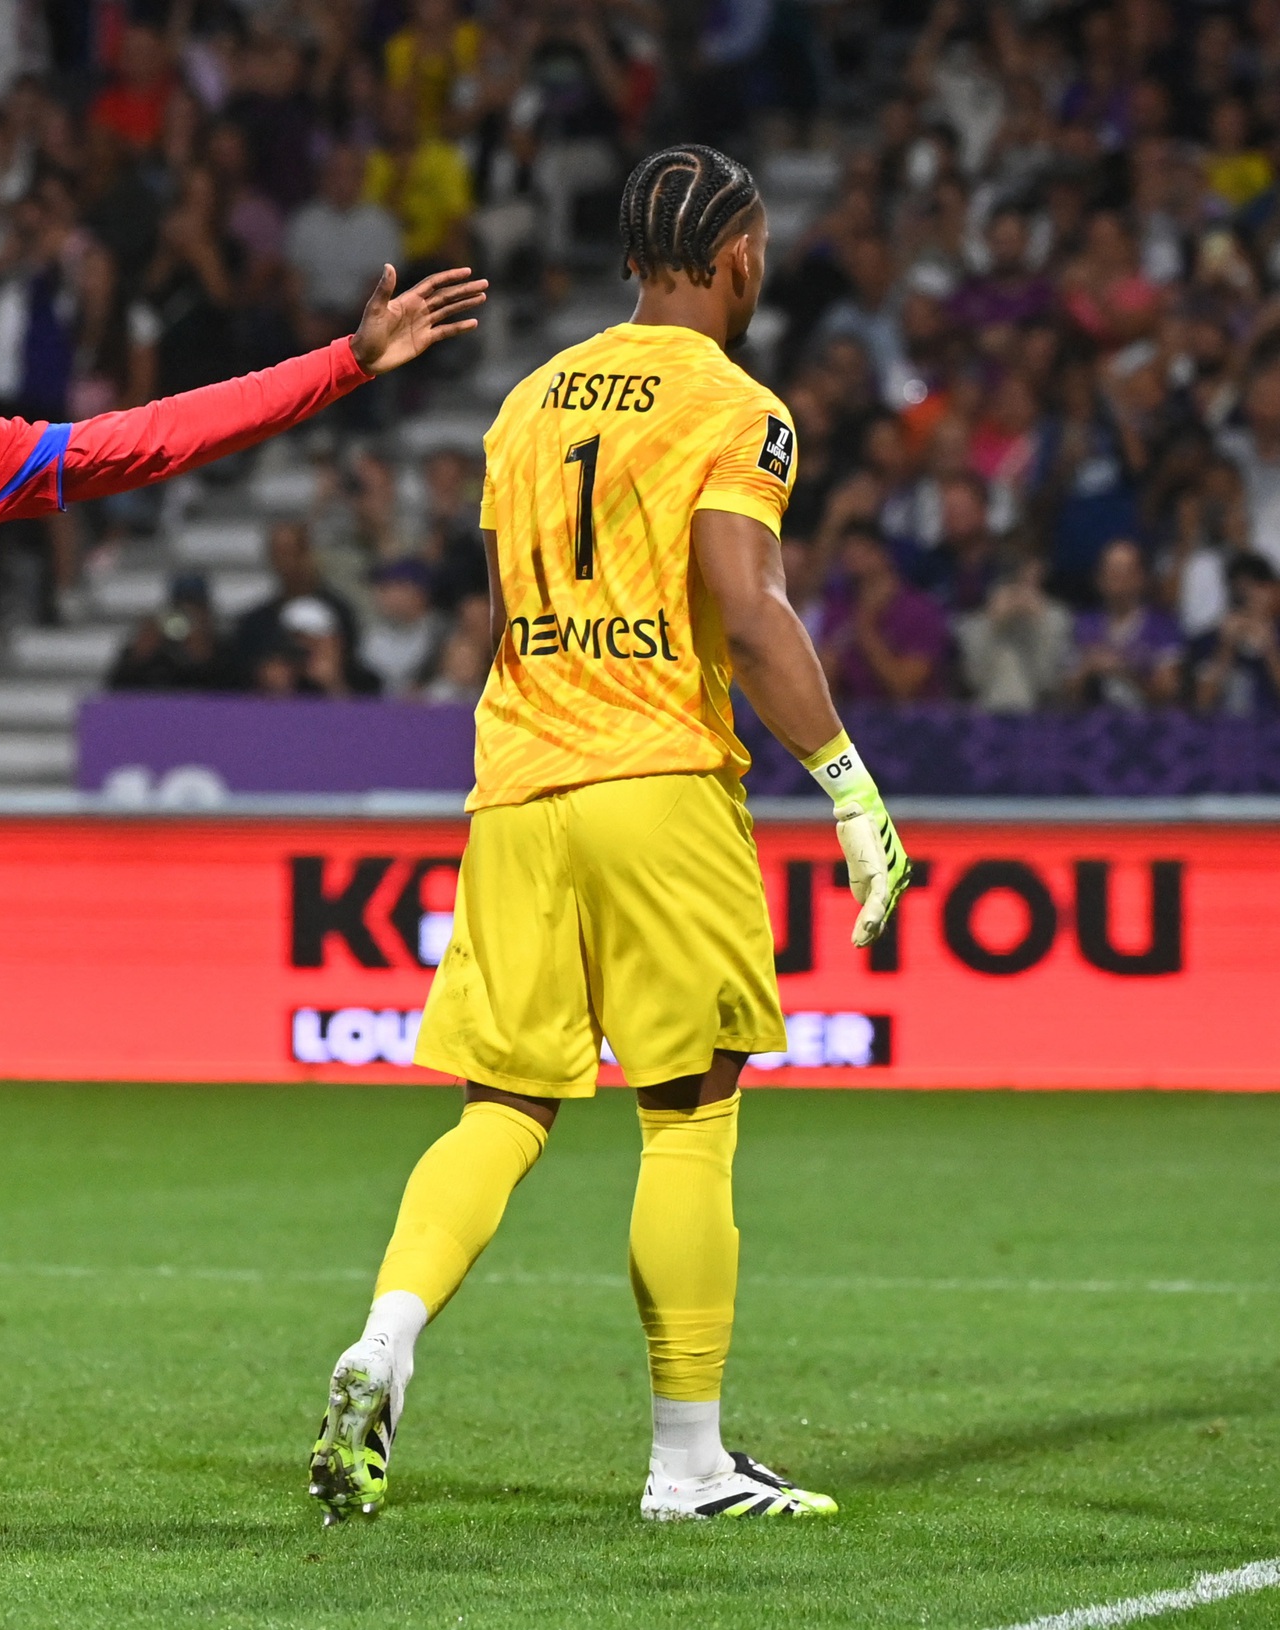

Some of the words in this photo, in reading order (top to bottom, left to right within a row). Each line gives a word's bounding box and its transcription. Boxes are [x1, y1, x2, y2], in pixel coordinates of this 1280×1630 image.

[541, 372, 660, 413] RESTES
[766, 441, 787, 463] LIGUE
[564, 433, 600, 580] 1
[826, 755, 853, 779] 50
[293, 1006, 424, 1067] LOU
